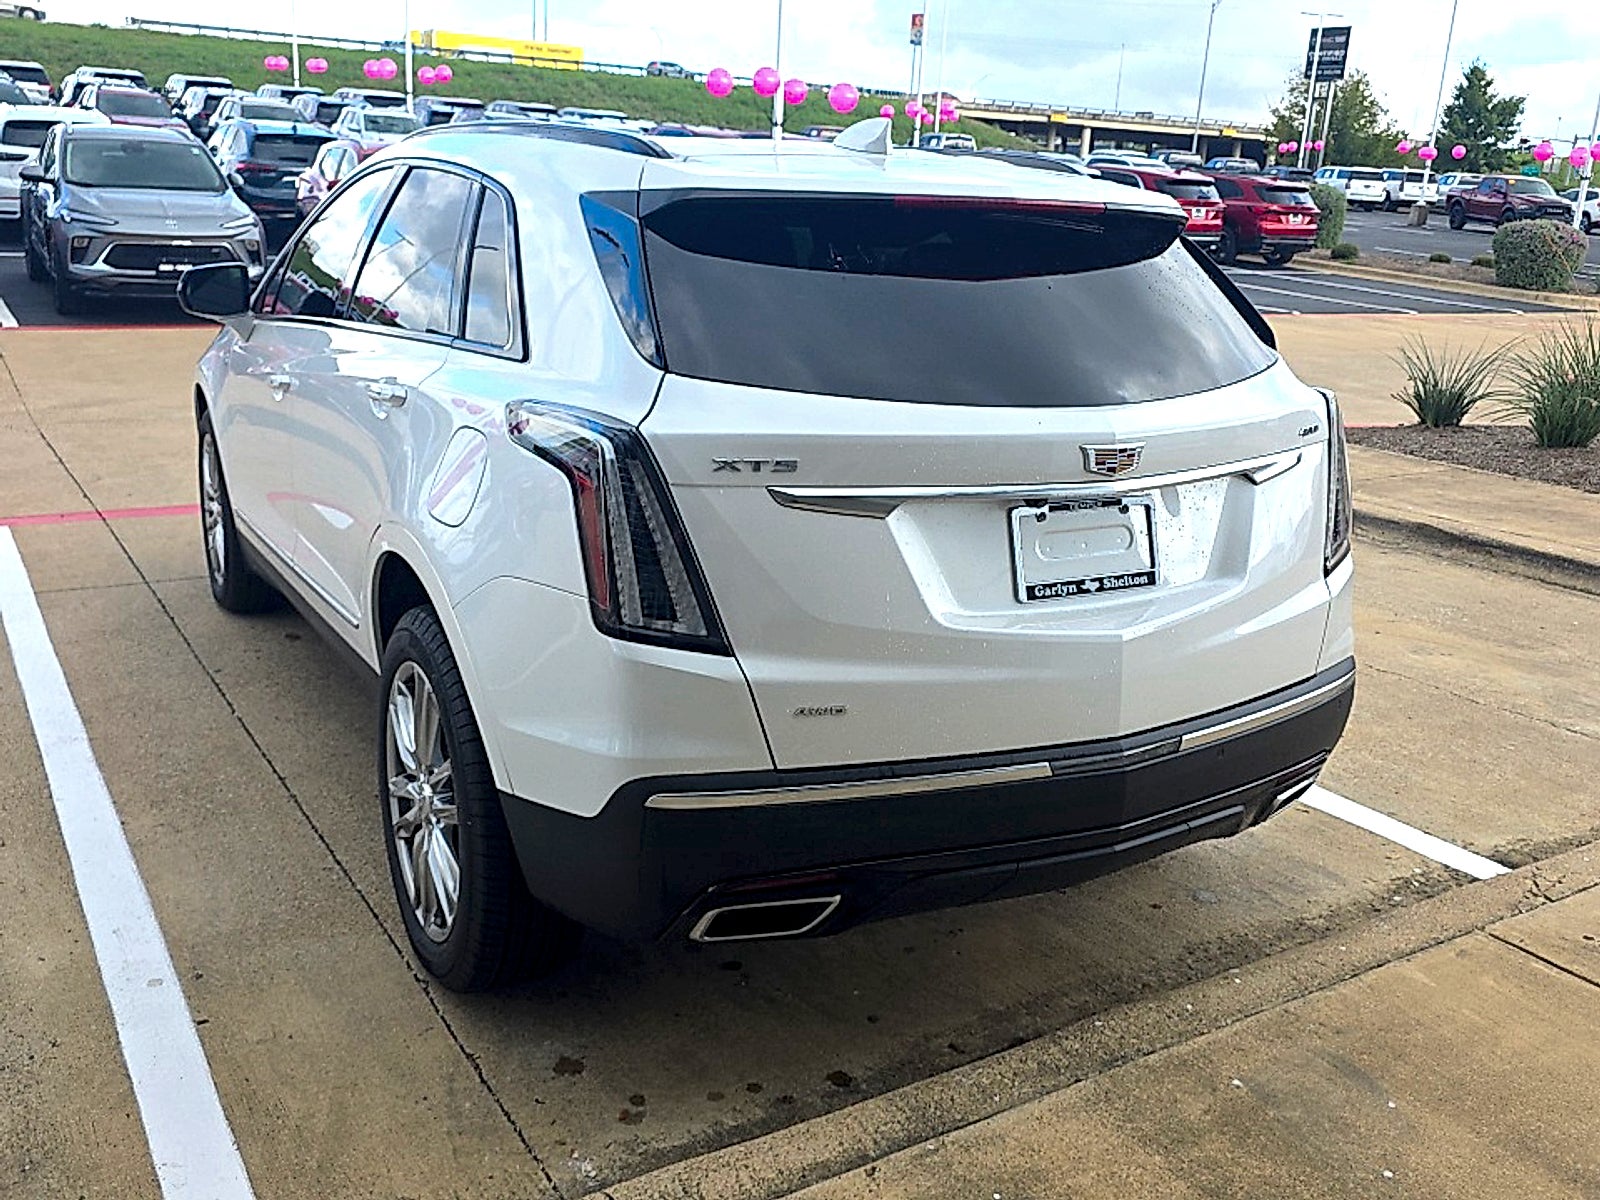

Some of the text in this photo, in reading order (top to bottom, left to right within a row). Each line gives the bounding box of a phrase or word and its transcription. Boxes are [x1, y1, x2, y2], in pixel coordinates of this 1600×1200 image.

[711, 457, 800, 472] XT5
[1034, 574, 1149, 597] Garlyn Shelton
[793, 704, 847, 718] AWD
